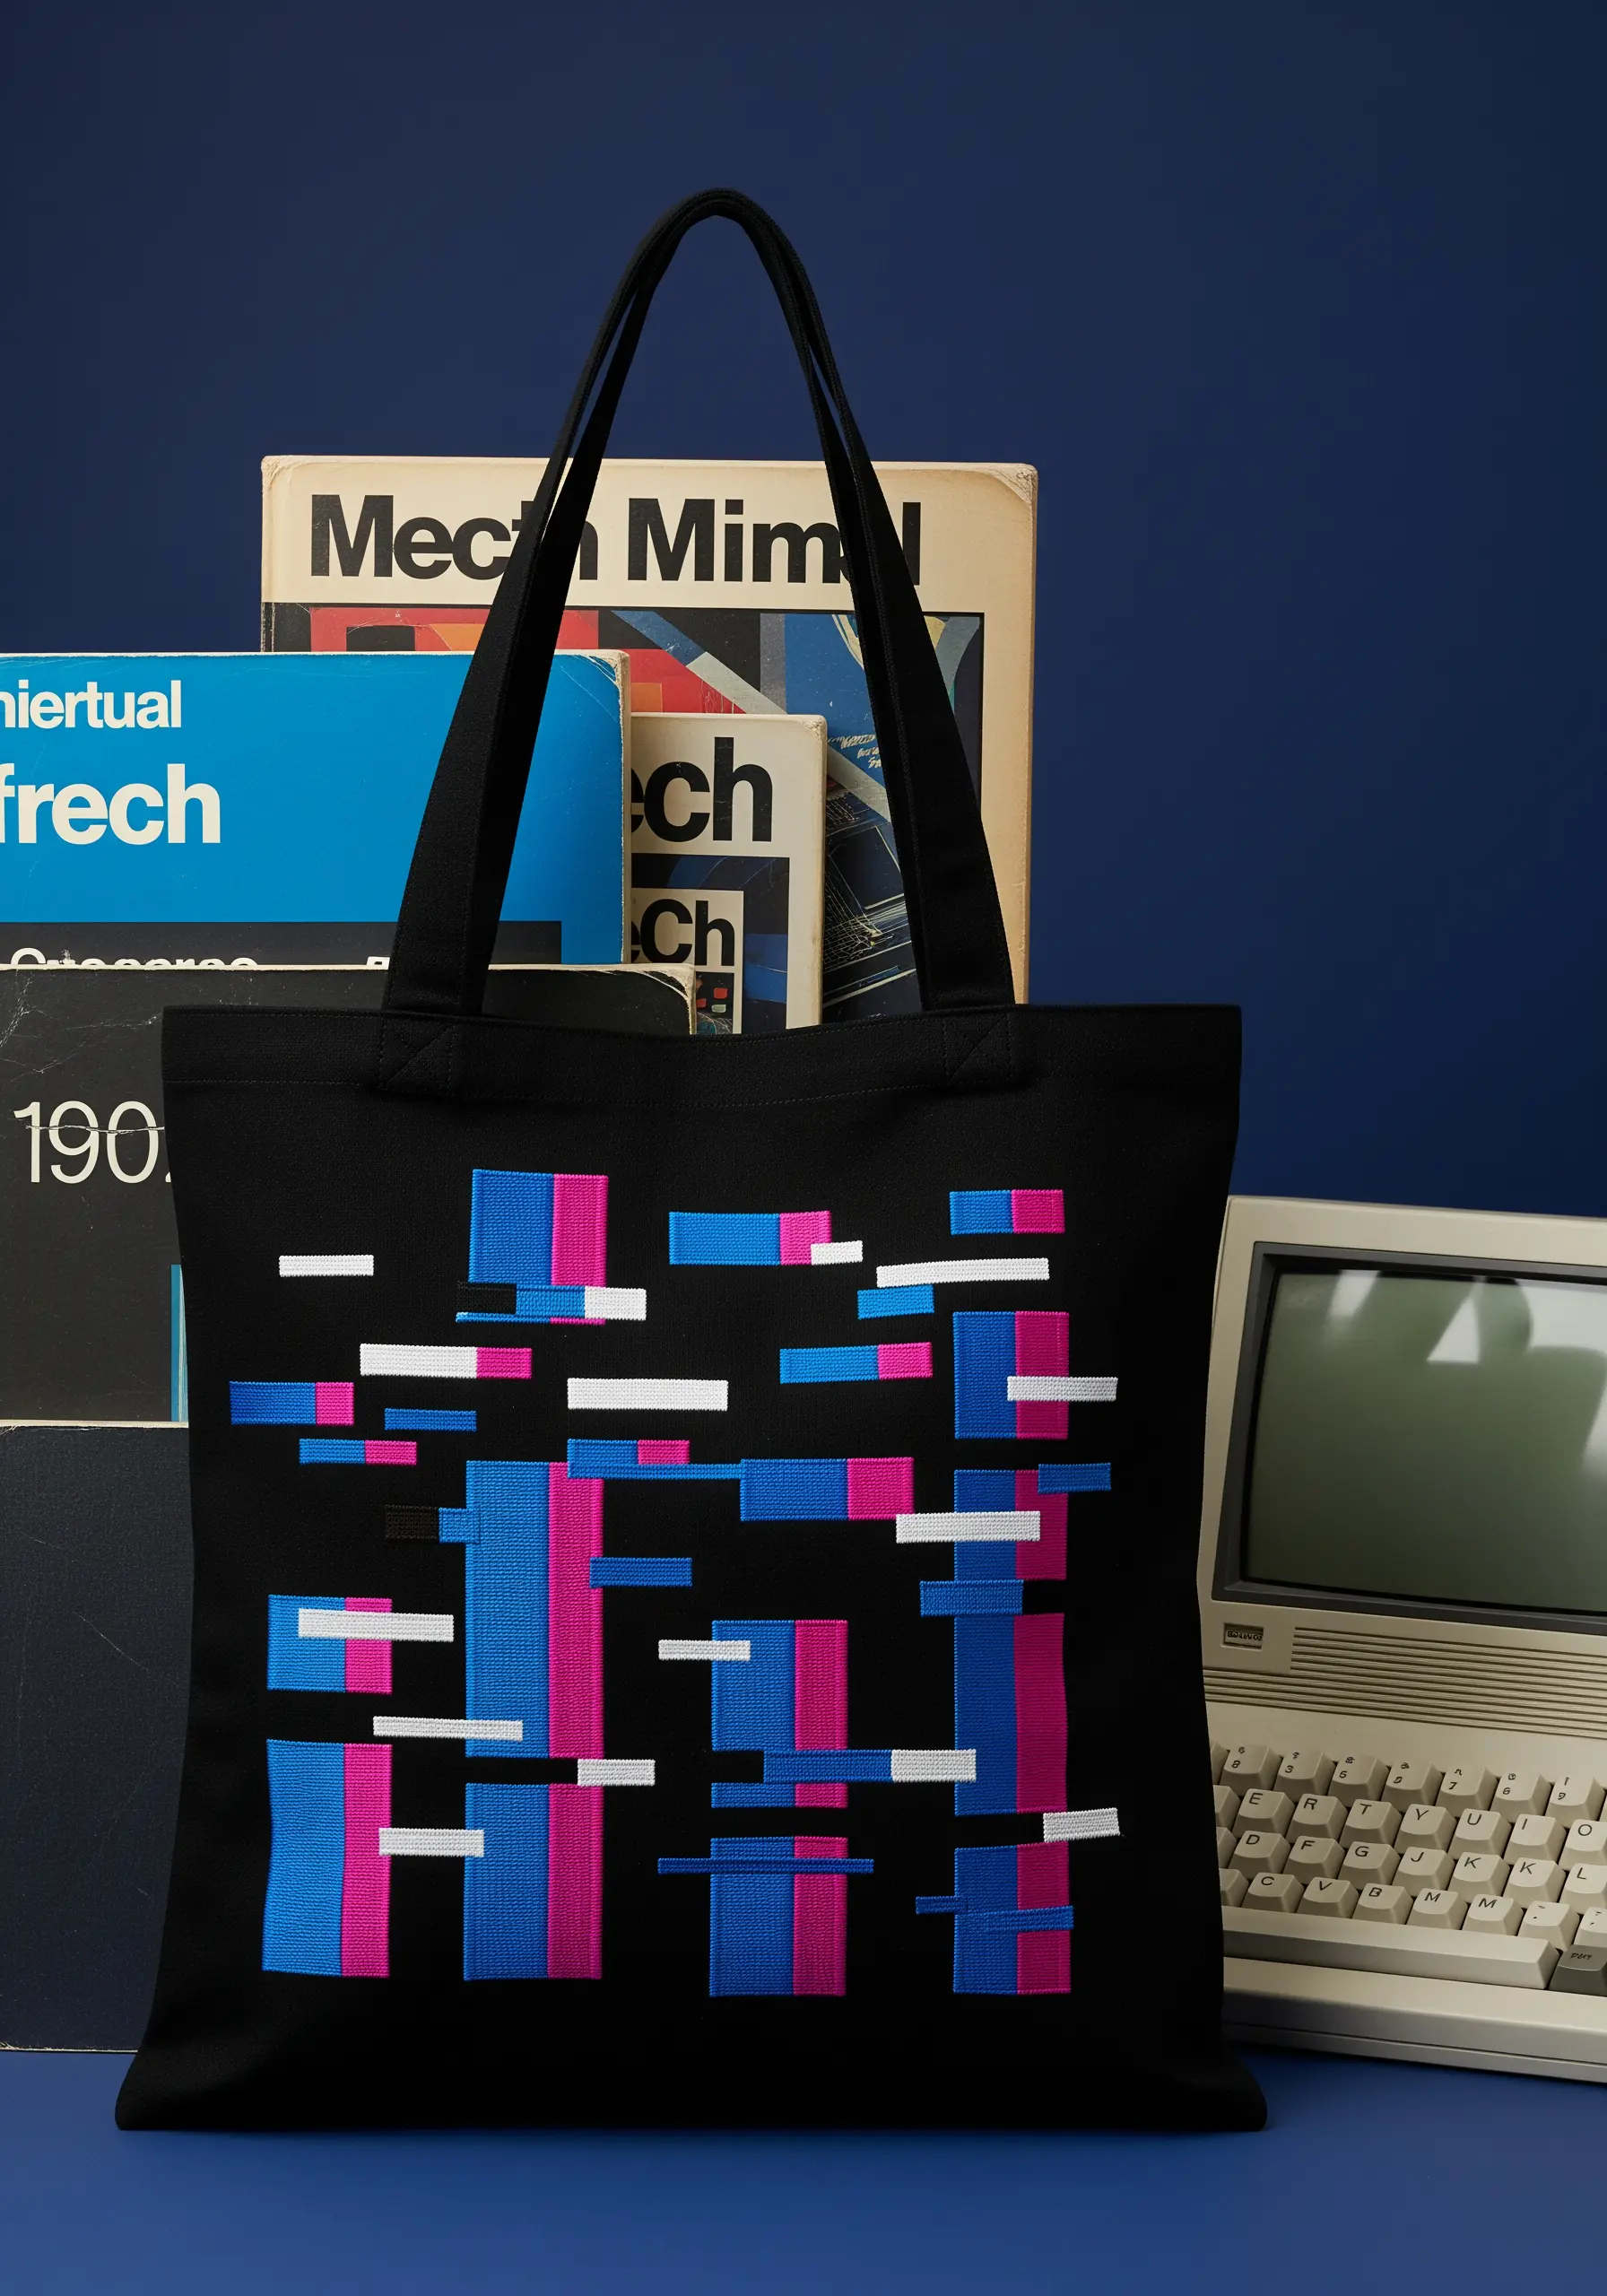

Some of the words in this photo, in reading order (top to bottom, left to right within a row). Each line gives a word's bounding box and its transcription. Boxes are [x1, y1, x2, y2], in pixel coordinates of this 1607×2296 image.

[628, 498, 921, 586] Miml
[631, 736, 773, 842] ch
[631, 899, 735, 966] Ch
[13, 1100, 171, 1184] 190
[1248, 1792, 1264, 1805] E
[1303, 1797, 1318, 1811] R
[1359, 1803, 1372, 1815] T
[1415, 1808, 1429, 1821] Y
[1466, 1813, 1482, 1826] U
[1246, 1834, 1260, 1845] D
[1300, 1839, 1316, 1850] F
[1354, 1845, 1369, 1857] G
[1410, 1851, 1425, 1863] J
[1464, 1857, 1481, 1869] K
[1519, 1861, 1535, 1874] K
[1577, 1867, 1587, 1880] L
[1261, 1876, 1275, 1886] C
[1319, 1881, 1333, 1892] V
[1368, 1887, 1383, 1898] B
[1424, 1892, 1441, 1903] M
[1478, 1898, 1498, 1909] M
